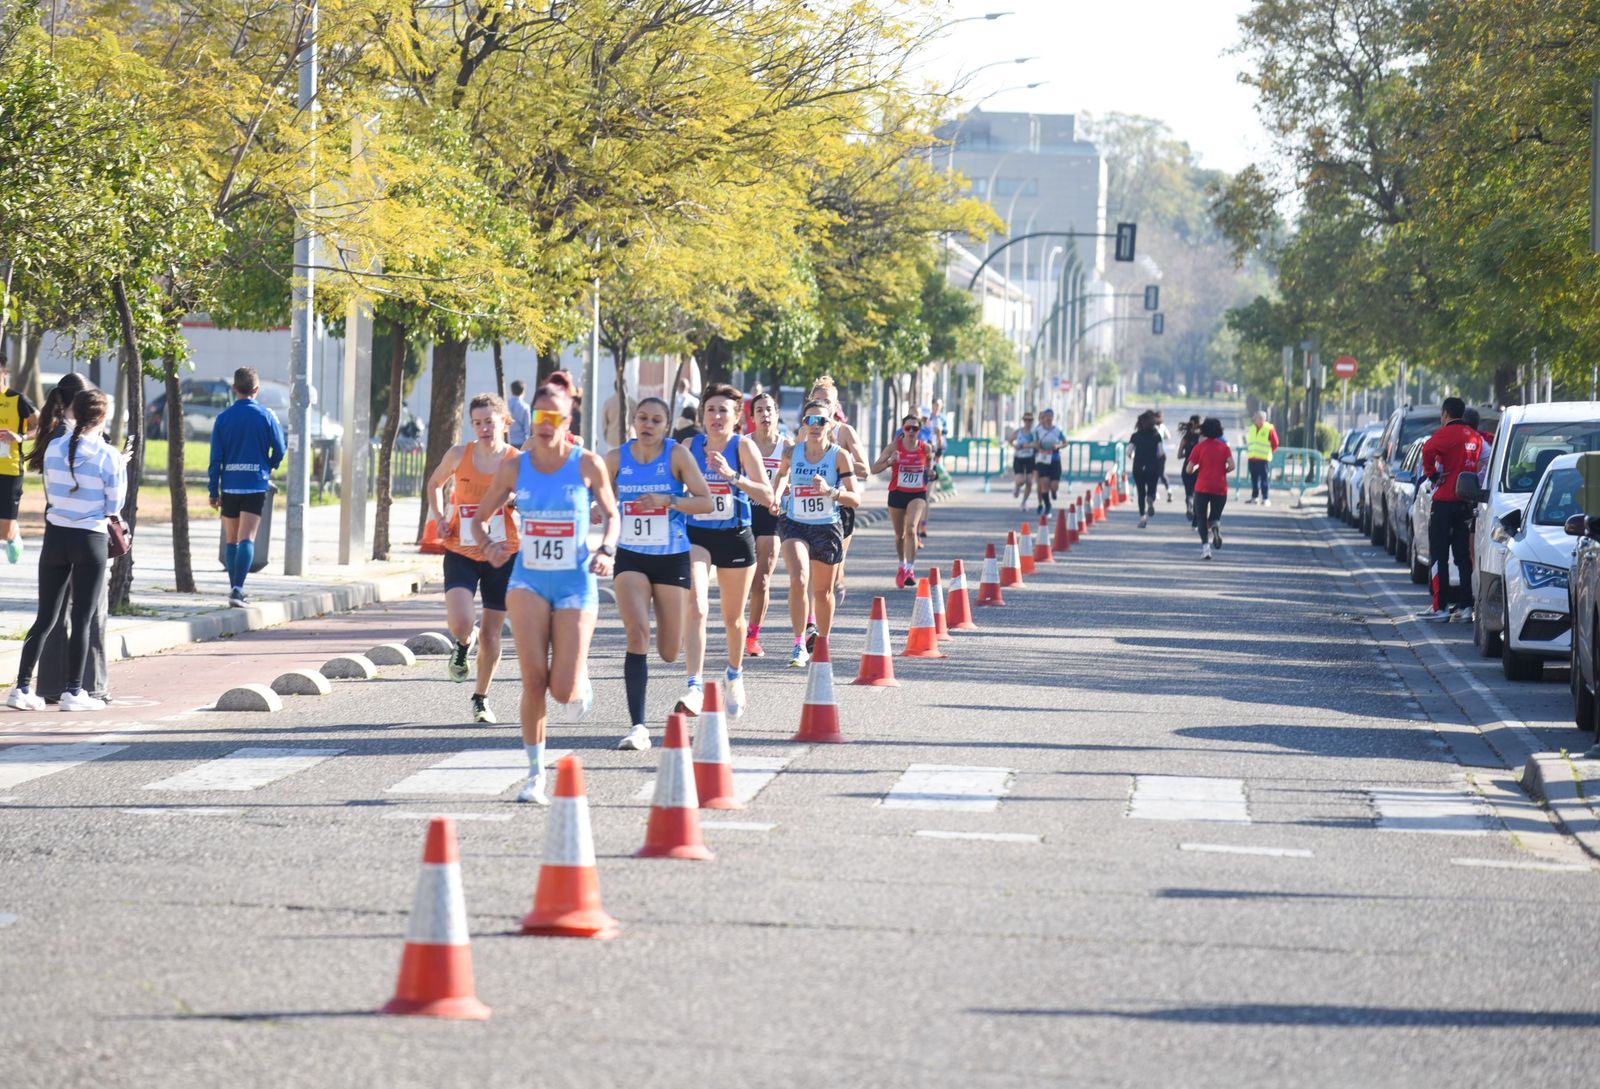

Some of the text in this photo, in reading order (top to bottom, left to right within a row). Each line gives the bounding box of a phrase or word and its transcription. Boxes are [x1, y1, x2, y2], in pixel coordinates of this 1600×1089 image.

[903, 473, 919, 483] 207
[617, 483, 672, 493] TROTASIERRA
[711, 496, 725, 512] 6
[801, 497, 824, 513] 195
[634, 518, 651, 536] 91
[533, 539, 564, 560] 145
